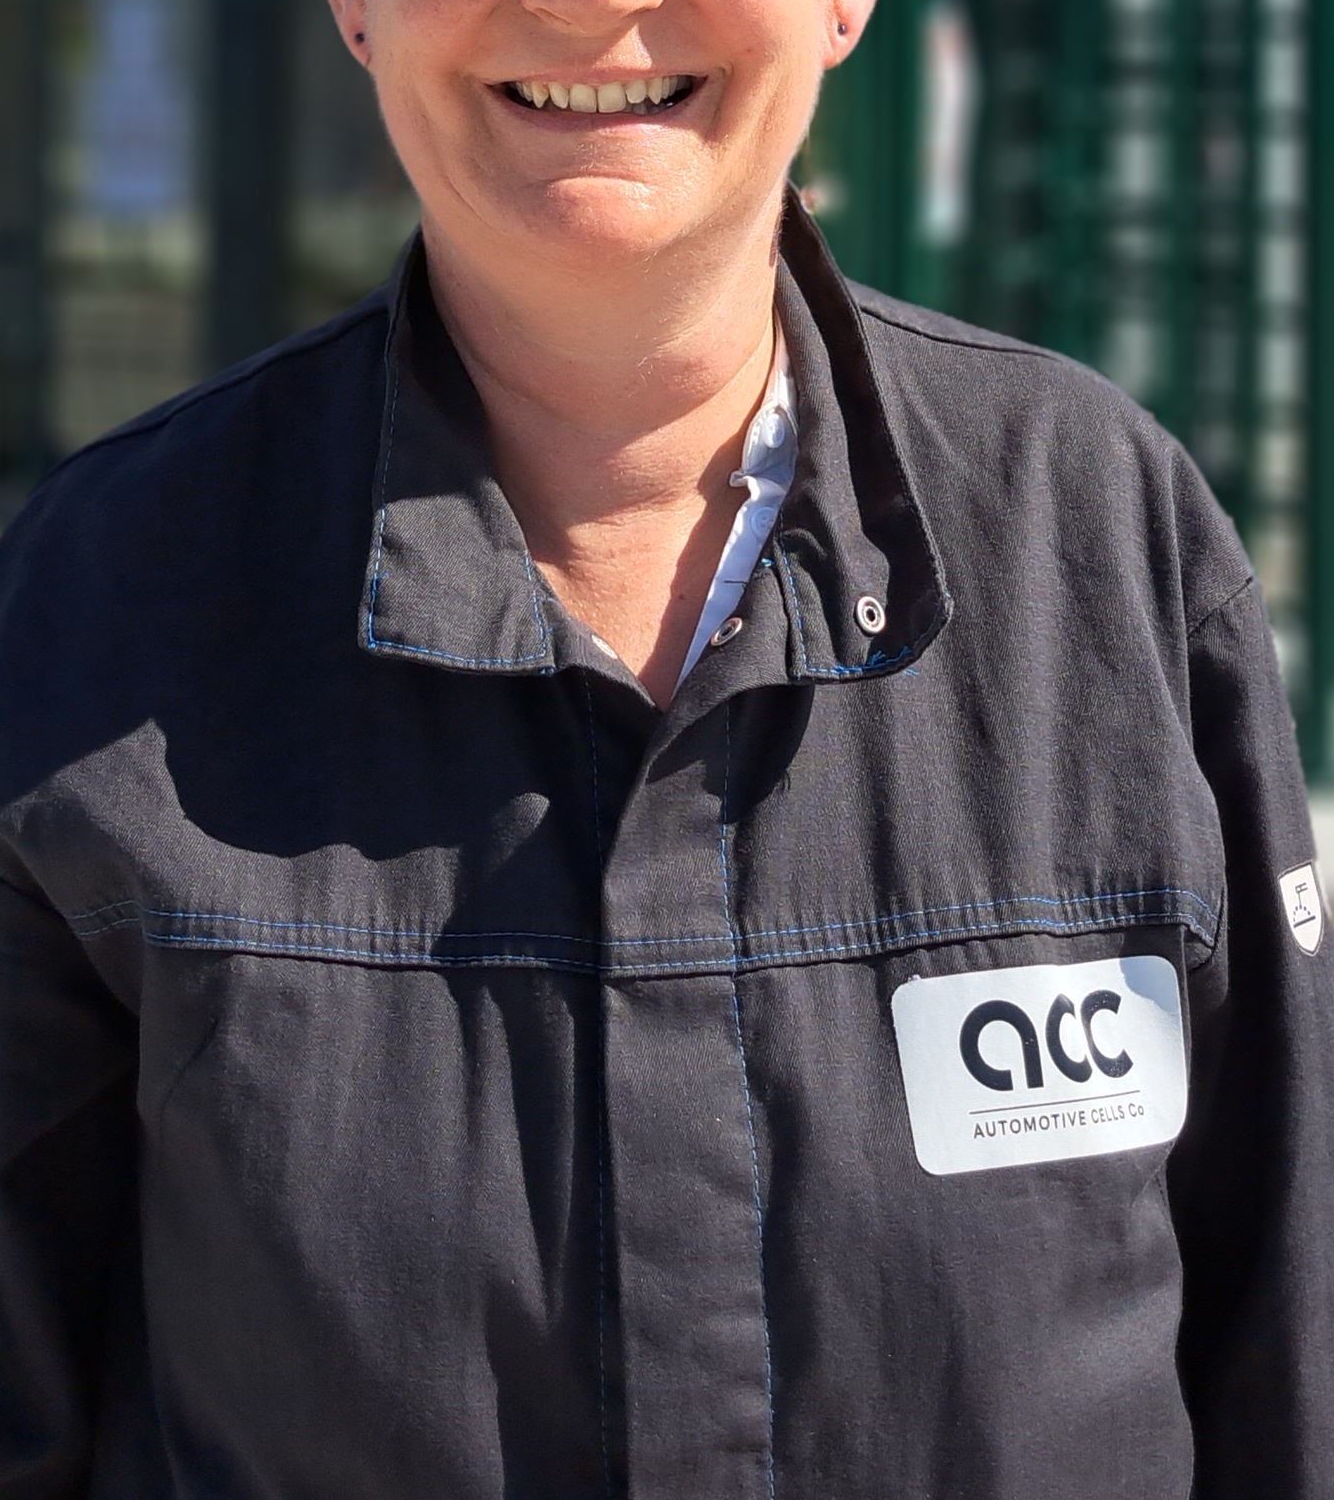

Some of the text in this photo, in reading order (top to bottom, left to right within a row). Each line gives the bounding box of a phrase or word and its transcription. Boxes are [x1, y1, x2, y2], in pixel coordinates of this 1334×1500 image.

[959, 989, 1133, 1091] acc
[973, 1102, 1145, 1139] AUTOMOTIVE CELLS Co
